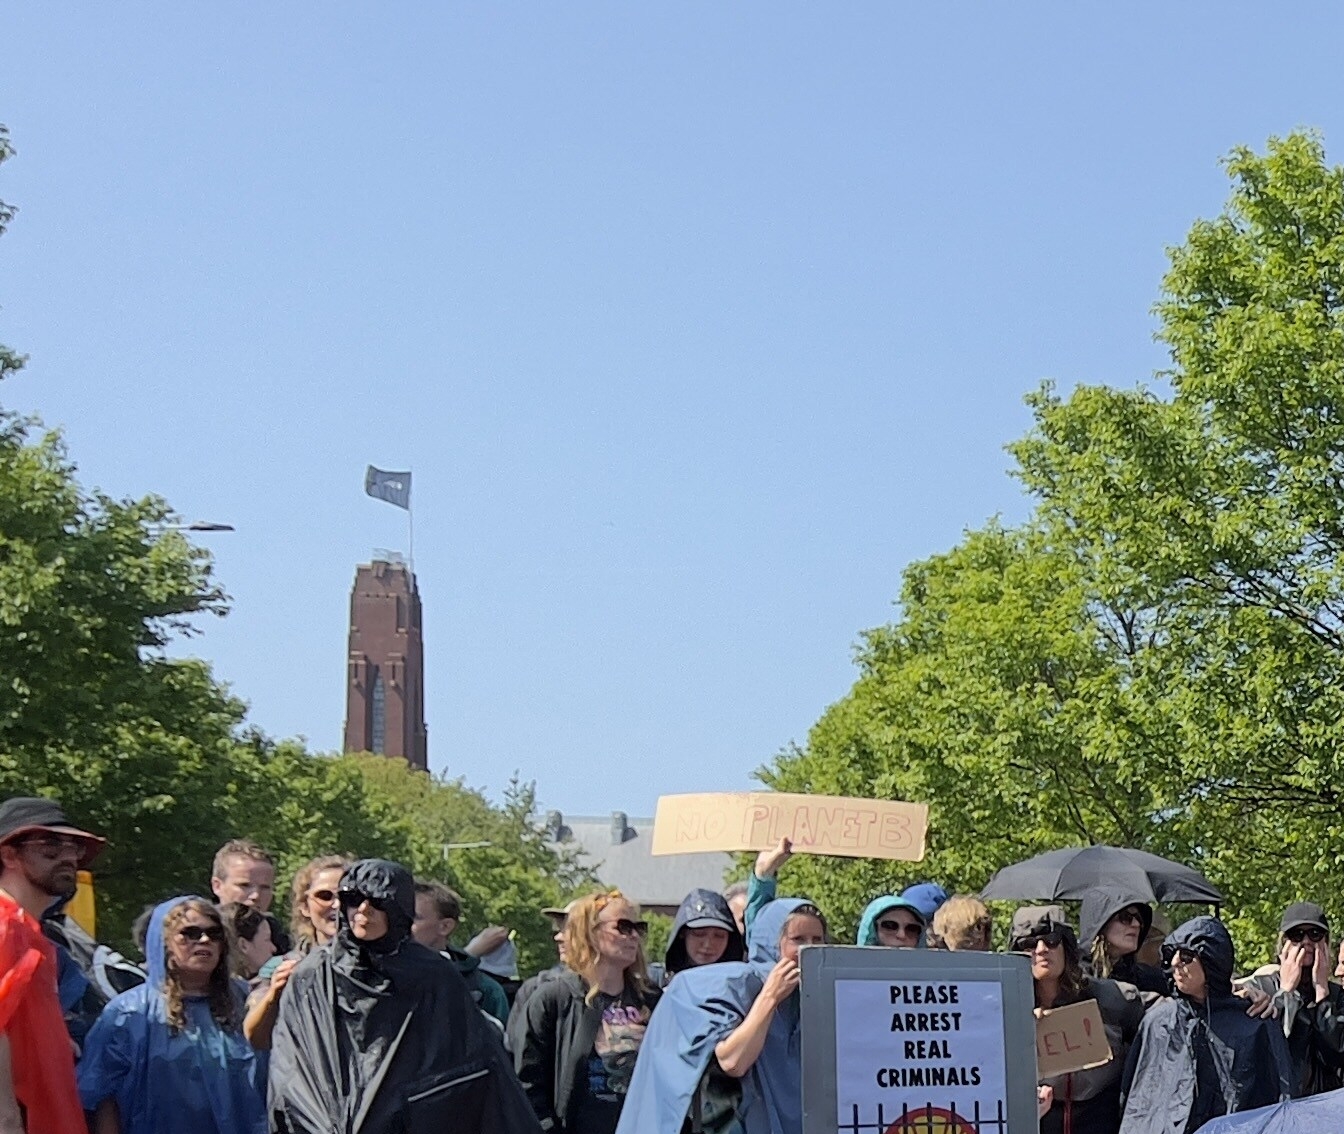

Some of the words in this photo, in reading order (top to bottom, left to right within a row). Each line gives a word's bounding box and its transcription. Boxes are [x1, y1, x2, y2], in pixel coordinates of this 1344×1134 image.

[675, 810, 727, 843] NO
[741, 804, 877, 849] PLANET
[879, 812, 913, 850] B
[890, 985, 959, 1004] PLEASE
[890, 1012, 961, 1032] ARREST
[1036, 1017, 1093, 1057] EL!
[904, 1040, 952, 1059] REAL
[876, 1066, 981, 1088] CRIMINALS
